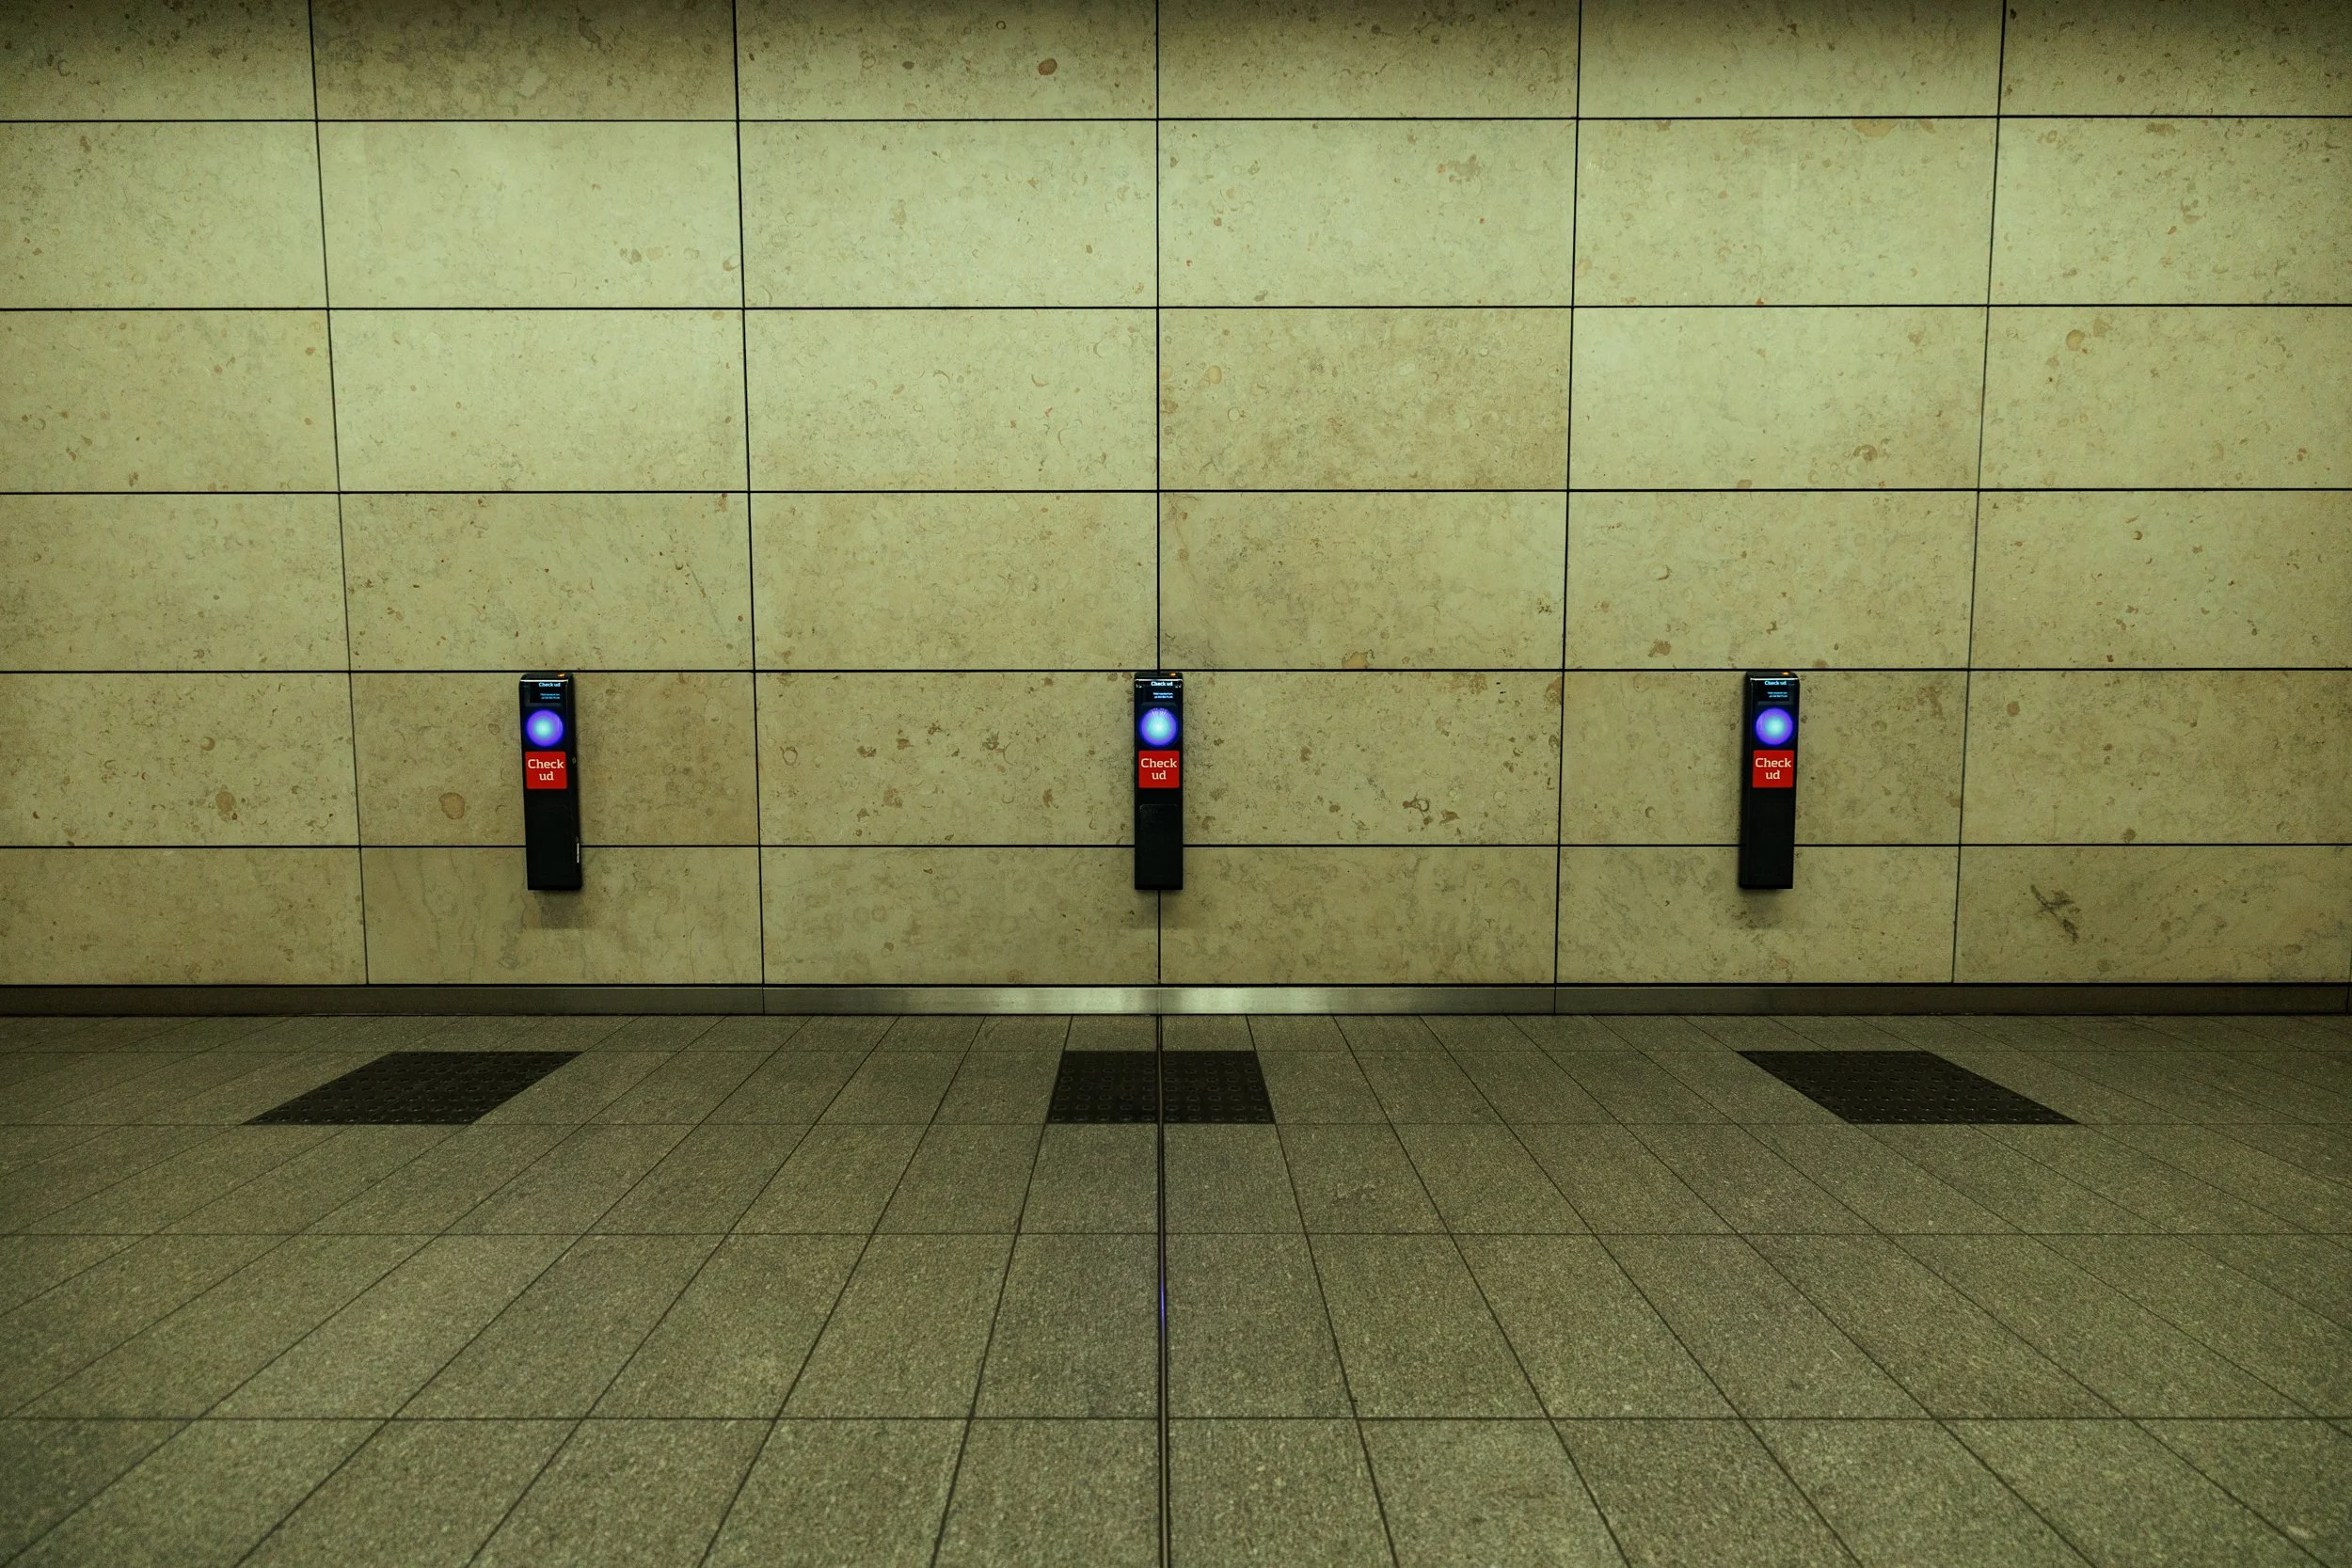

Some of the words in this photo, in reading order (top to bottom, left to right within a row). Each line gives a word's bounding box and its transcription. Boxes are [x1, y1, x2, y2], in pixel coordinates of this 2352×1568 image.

[528, 759, 564, 768] Check
[1141, 758, 1177, 768] Check
[1755, 757, 1791, 768] Check
[539, 771, 553, 781] ud
[1152, 770, 1167, 780] ud
[1765, 769, 1780, 780] ud
